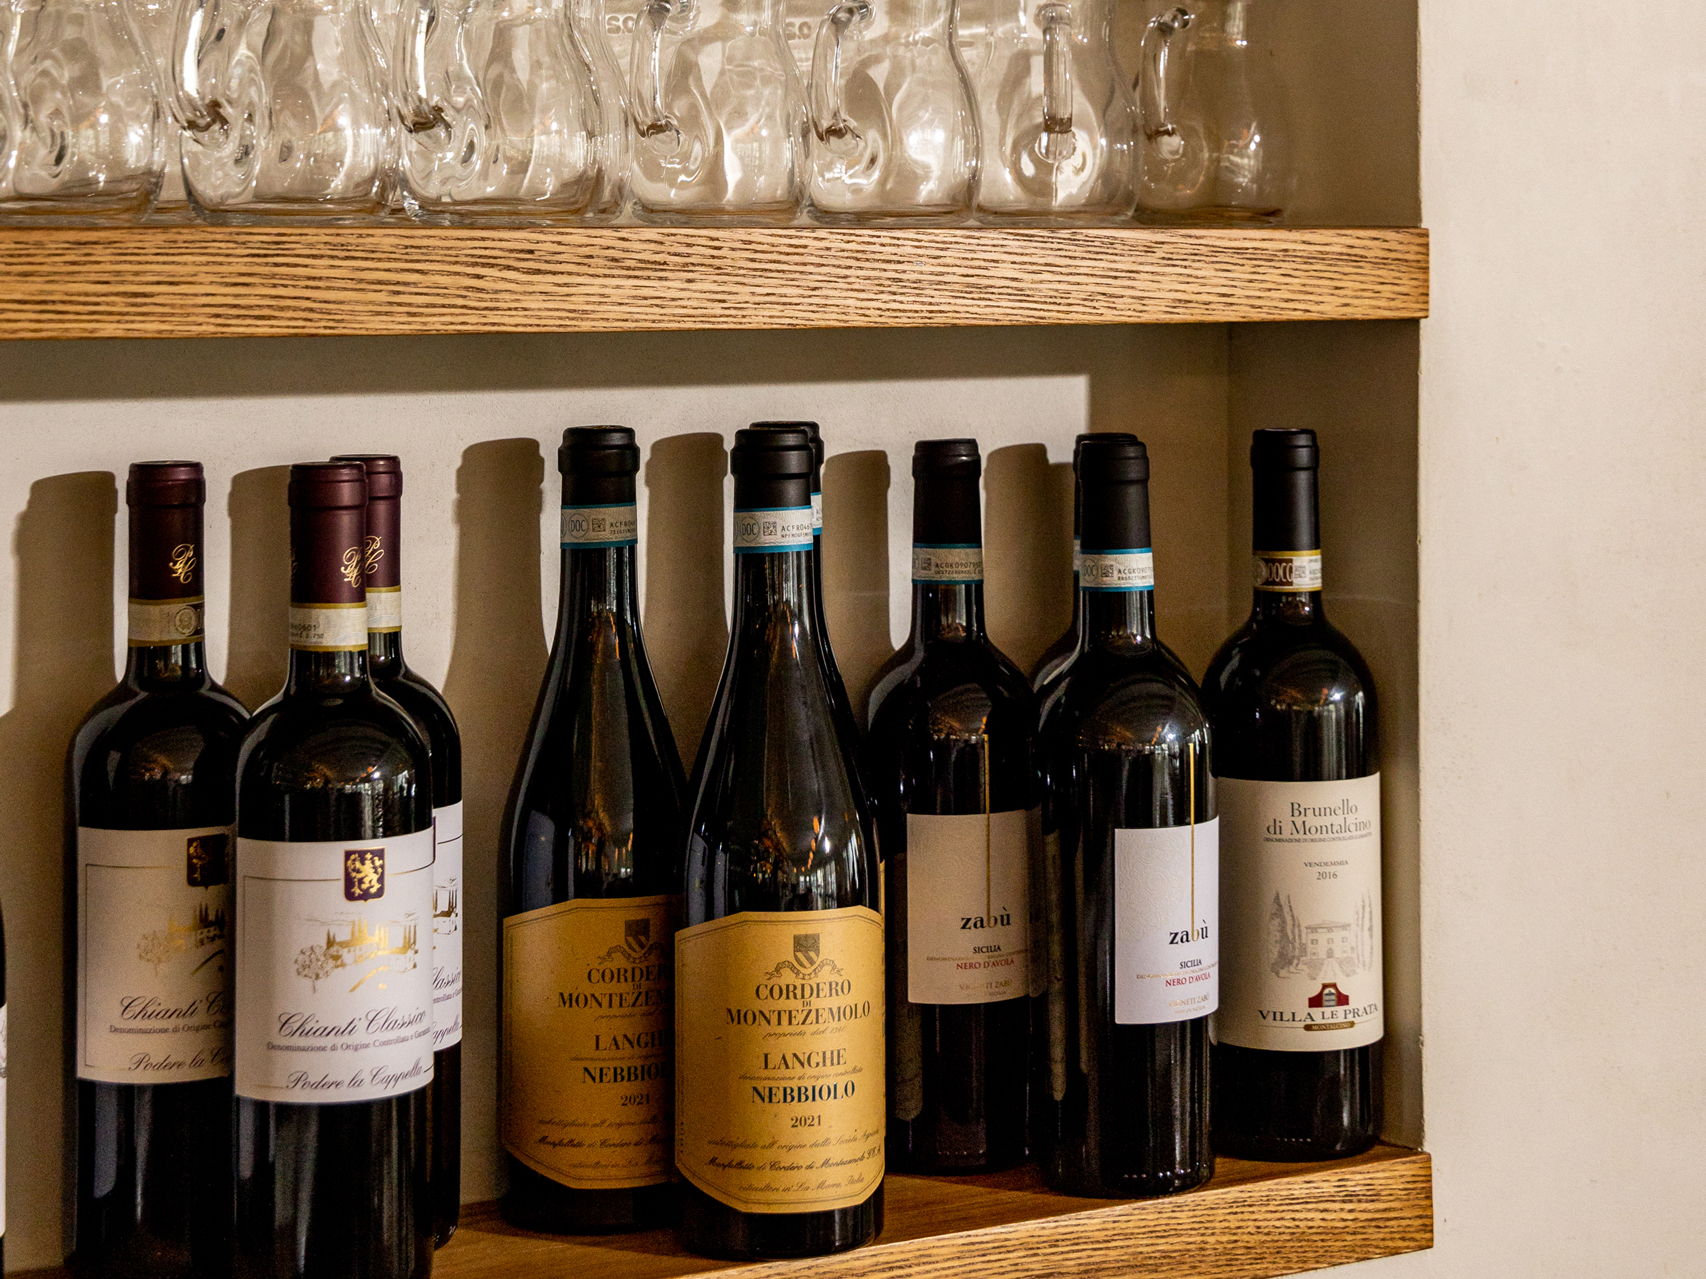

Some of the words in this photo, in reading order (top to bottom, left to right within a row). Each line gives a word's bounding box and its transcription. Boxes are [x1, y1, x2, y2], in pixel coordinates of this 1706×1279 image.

[570, 519, 587, 533] DOC
[741, 522, 757, 536] DOC
[1290, 799, 1358, 817] Brunello
[1266, 818, 1283, 835] di
[1290, 817, 1371, 836] Montalcino
[1304, 860, 1349, 869] VENDEMMIA
[1316, 871, 1338, 881] 2016
[960, 906, 1011, 931] zabù
[1169, 919, 1209, 946] zabù
[973, 945, 1002, 954] SICILIA
[957, 961, 981, 971] NERO
[983, 959, 1015, 969] D'AVOLA
[1180, 959, 1202, 969] SICILIA
[632, 982, 642, 990] DI
[1165, 977, 1187, 987] NERO
[1188, 972, 1211, 984] D'AVOLA
[755, 979, 852, 1001] CORDERO
[120, 995, 203, 1020] Chianti
[802, 1000, 812, 1008] DI
[1258, 1010, 1316, 1022] VILLA
[1321, 1010, 1339, 1020] LE
[1343, 1002, 1379, 1020] PRATA
[726, 1000, 871, 1026] MONTEZEMOLO
[109, 1024, 170, 1035] Denominazione
[172, 1024, 180, 1033] di
[278, 1010, 362, 1039] Chianti
[365, 1005, 427, 1036] Classico
[267, 1040, 328, 1053] Denominazione
[330, 1042, 340, 1052] di
[341, 1040, 371, 1052] Origine
[373, 1034, 410, 1048] Controllata
[128, 1051, 186, 1072] Podere
[188, 1046, 206, 1069] la
[762, 1048, 847, 1070] LANGHE
[285, 1070, 346, 1091] Podere
[347, 1069, 366, 1089] la
[370, 1056, 424, 1091] Cappella
[621, 1092, 650, 1107] 2021
[752, 1080, 856, 1104] NEBBIOLO
[790, 1114, 822, 1129] 2021
[769, 1160, 803, 1171] Cordero
